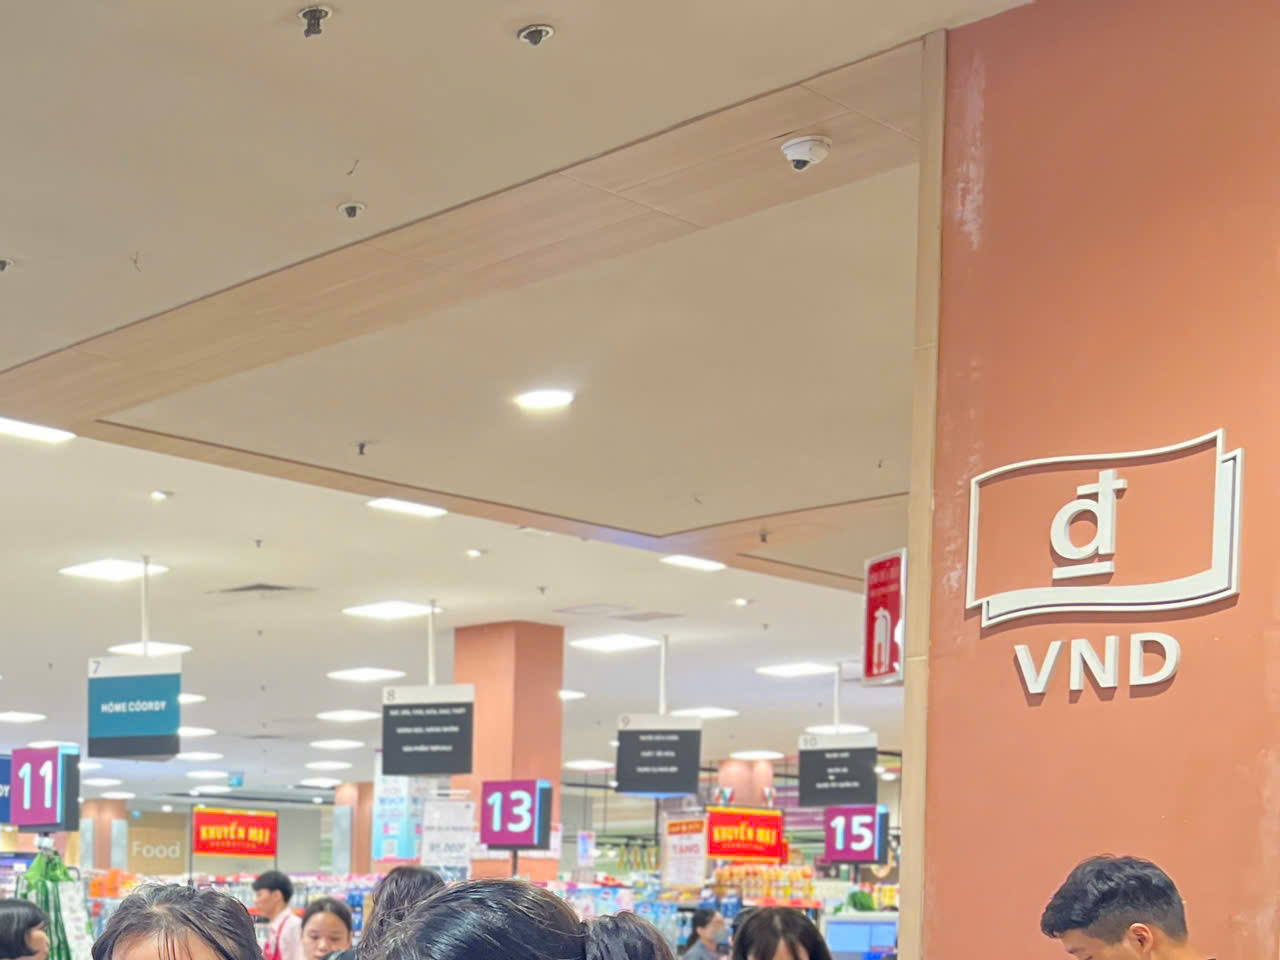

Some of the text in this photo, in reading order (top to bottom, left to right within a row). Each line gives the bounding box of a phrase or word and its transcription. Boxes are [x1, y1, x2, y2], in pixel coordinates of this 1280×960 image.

[92, 660, 101, 674] 7
[1014, 632, 1181, 694] VND
[18, 760, 52, 810] 11
[487, 790, 532, 832] 13
[132, 841, 180, 858] Food
[831, 815, 873, 851] 15
